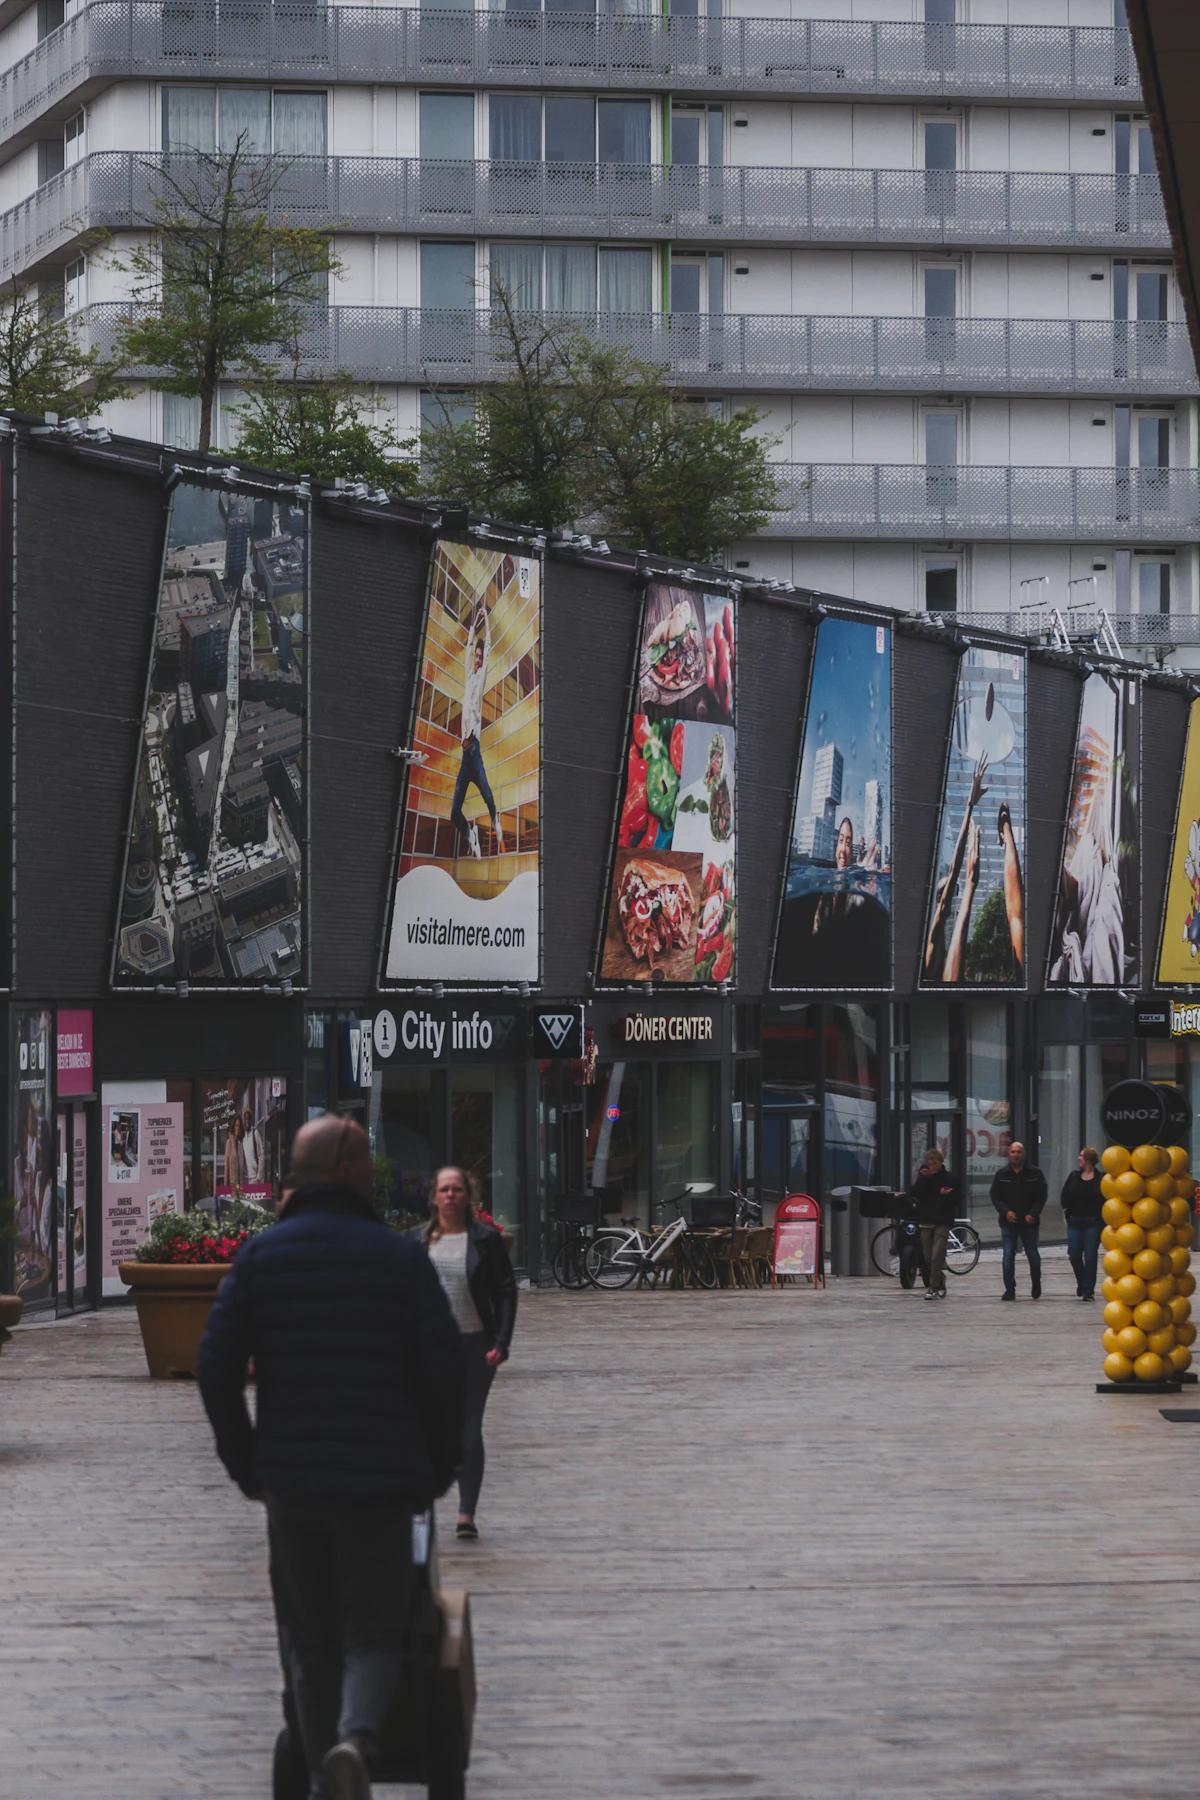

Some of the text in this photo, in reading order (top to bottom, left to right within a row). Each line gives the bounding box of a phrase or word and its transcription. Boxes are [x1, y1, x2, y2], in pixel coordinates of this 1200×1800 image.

[407, 917, 525, 948] visitalmere.com
[402, 1010, 493, 1058] City info
[625, 1013, 712, 1042] DÖNER CENTER
[147, 1117, 172, 1127] TOPMERKEN
